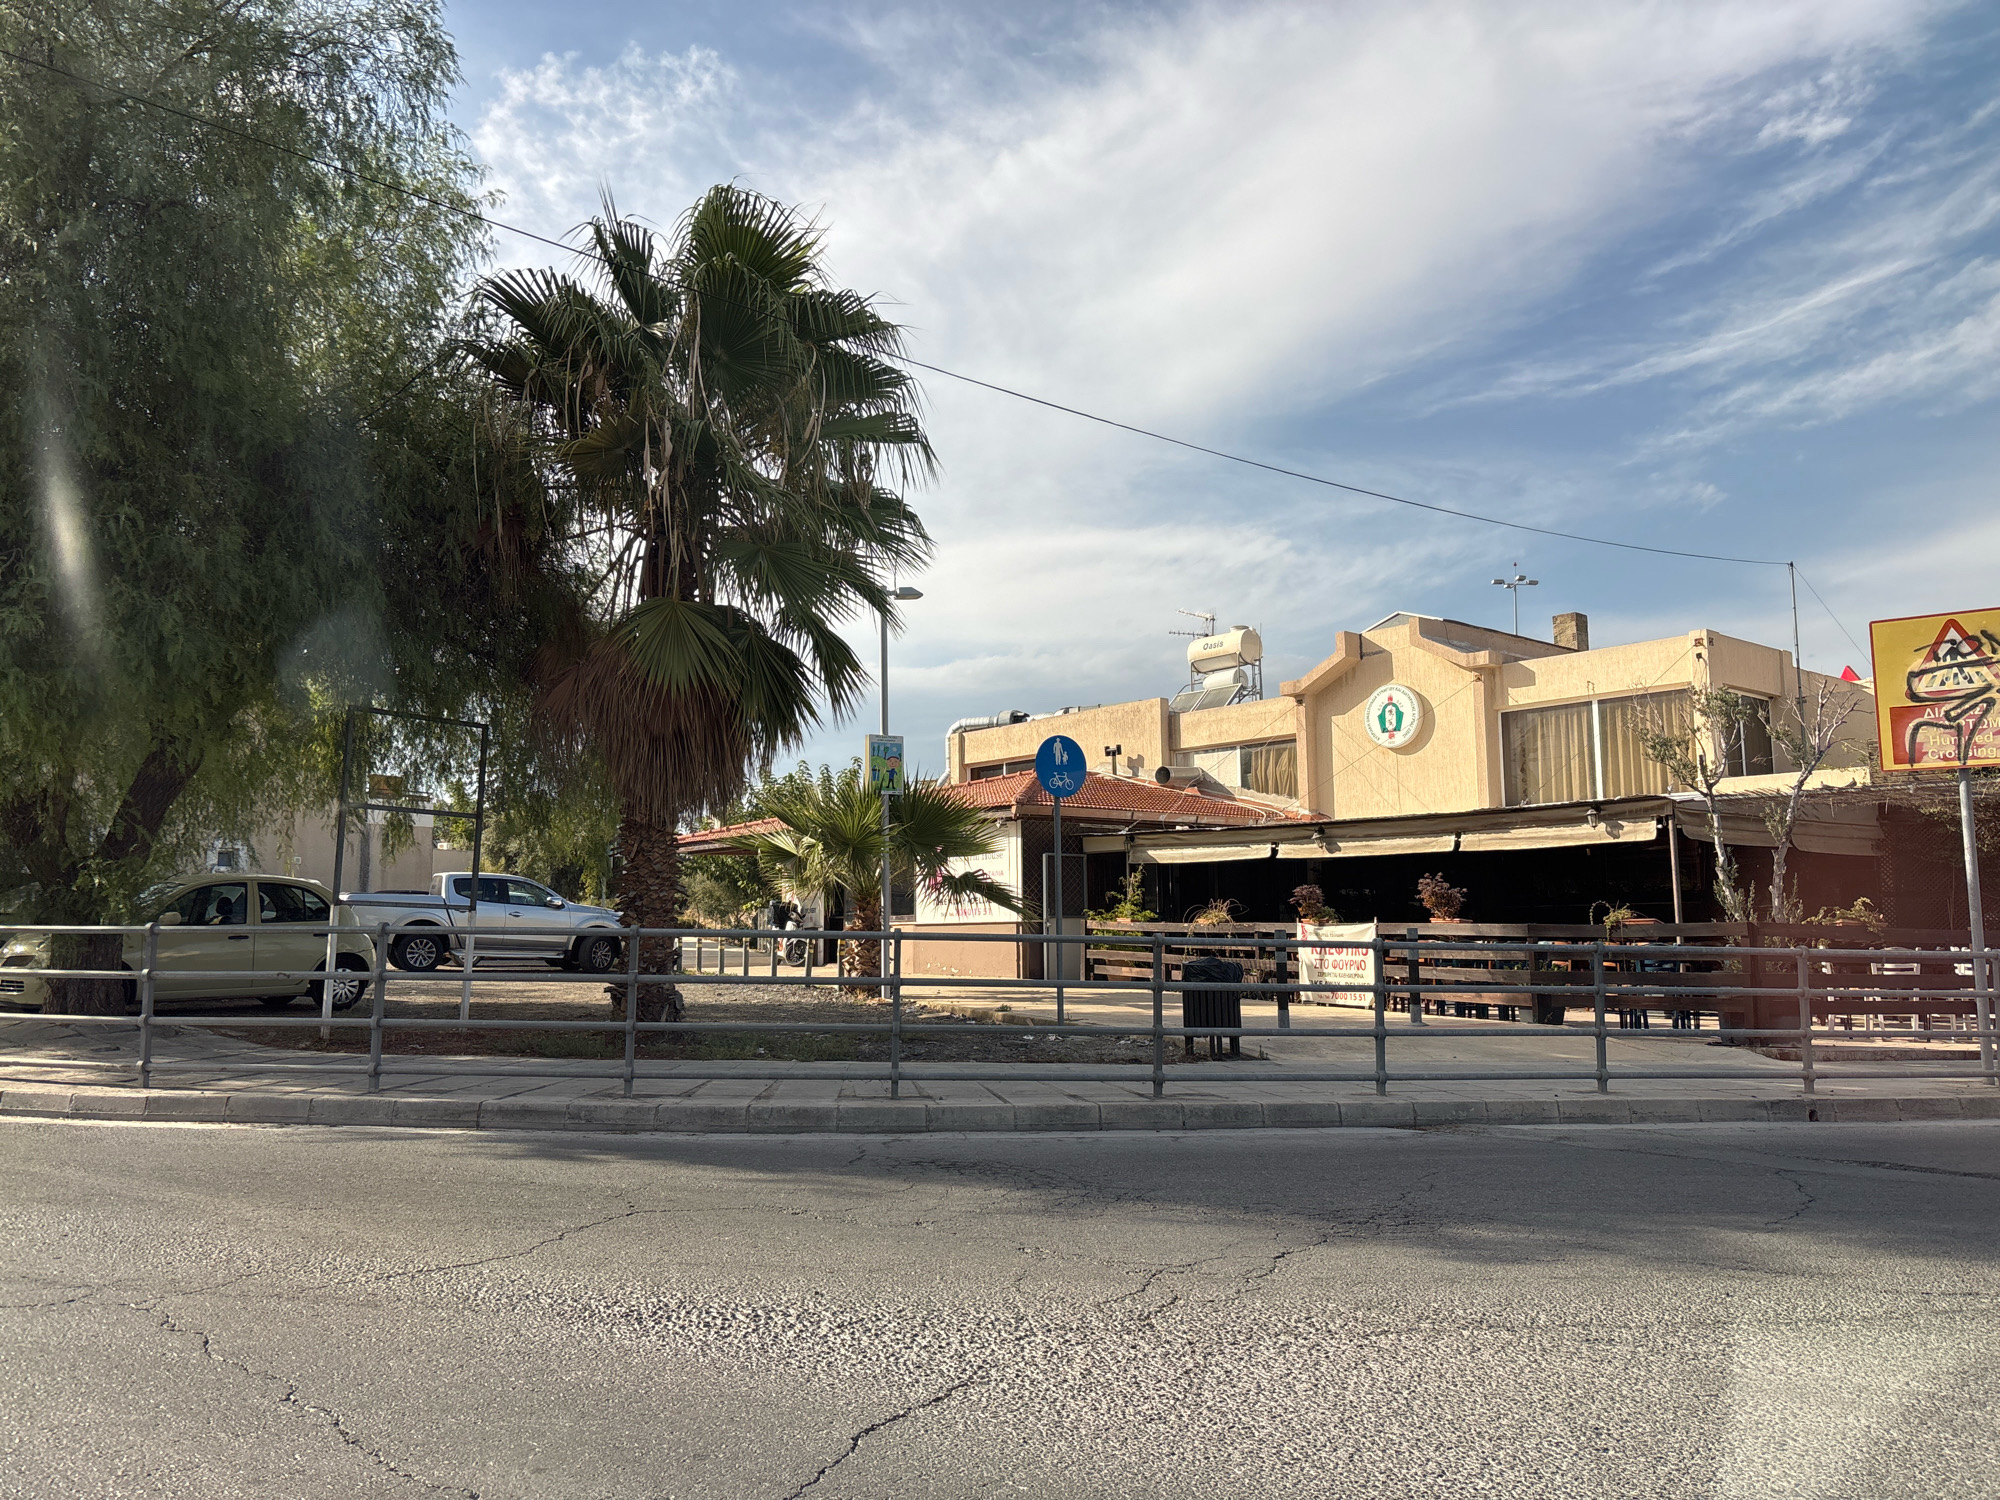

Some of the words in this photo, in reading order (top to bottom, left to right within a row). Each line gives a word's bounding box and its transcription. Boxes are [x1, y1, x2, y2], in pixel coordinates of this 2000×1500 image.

[1203, 641, 1223, 650] Oasis
[1314, 958, 1329, 969] ΣΤΟ
[1331, 959, 1366, 970] ΦΟΥΡΝΟ
[1331, 992, 1348, 1000] 7000
[1359, 993, 1366, 1001] 51
